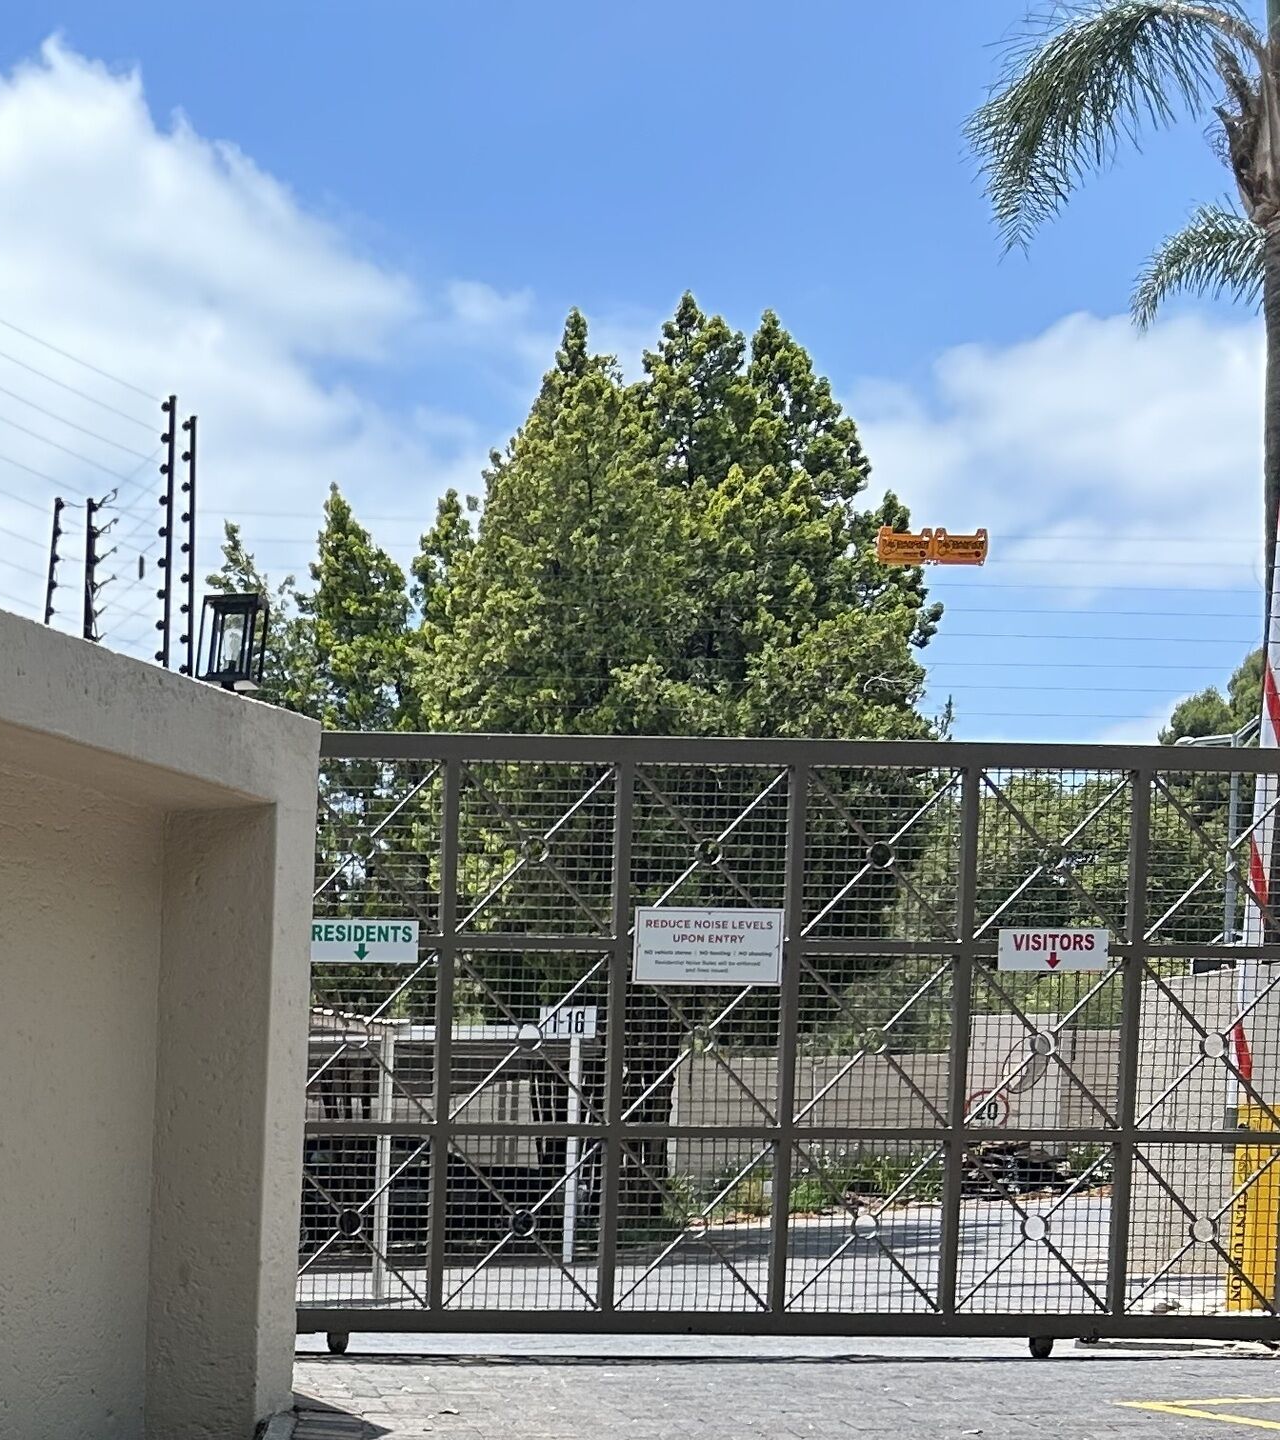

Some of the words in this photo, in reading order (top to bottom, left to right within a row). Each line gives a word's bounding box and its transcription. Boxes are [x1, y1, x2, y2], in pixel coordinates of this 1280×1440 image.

[311, 924, 413, 943] RESIDENTS
[645, 919, 690, 928] REDUCE
[694, 920, 728, 929] NOISE
[731, 920, 773, 930] LEVELS
[672, 934, 704, 942] UPON
[708, 934, 745, 943] ENTRY
[1013, 933, 1095, 951] VISITORS
[1231, 1189, 1248, 1302] CENTURON
